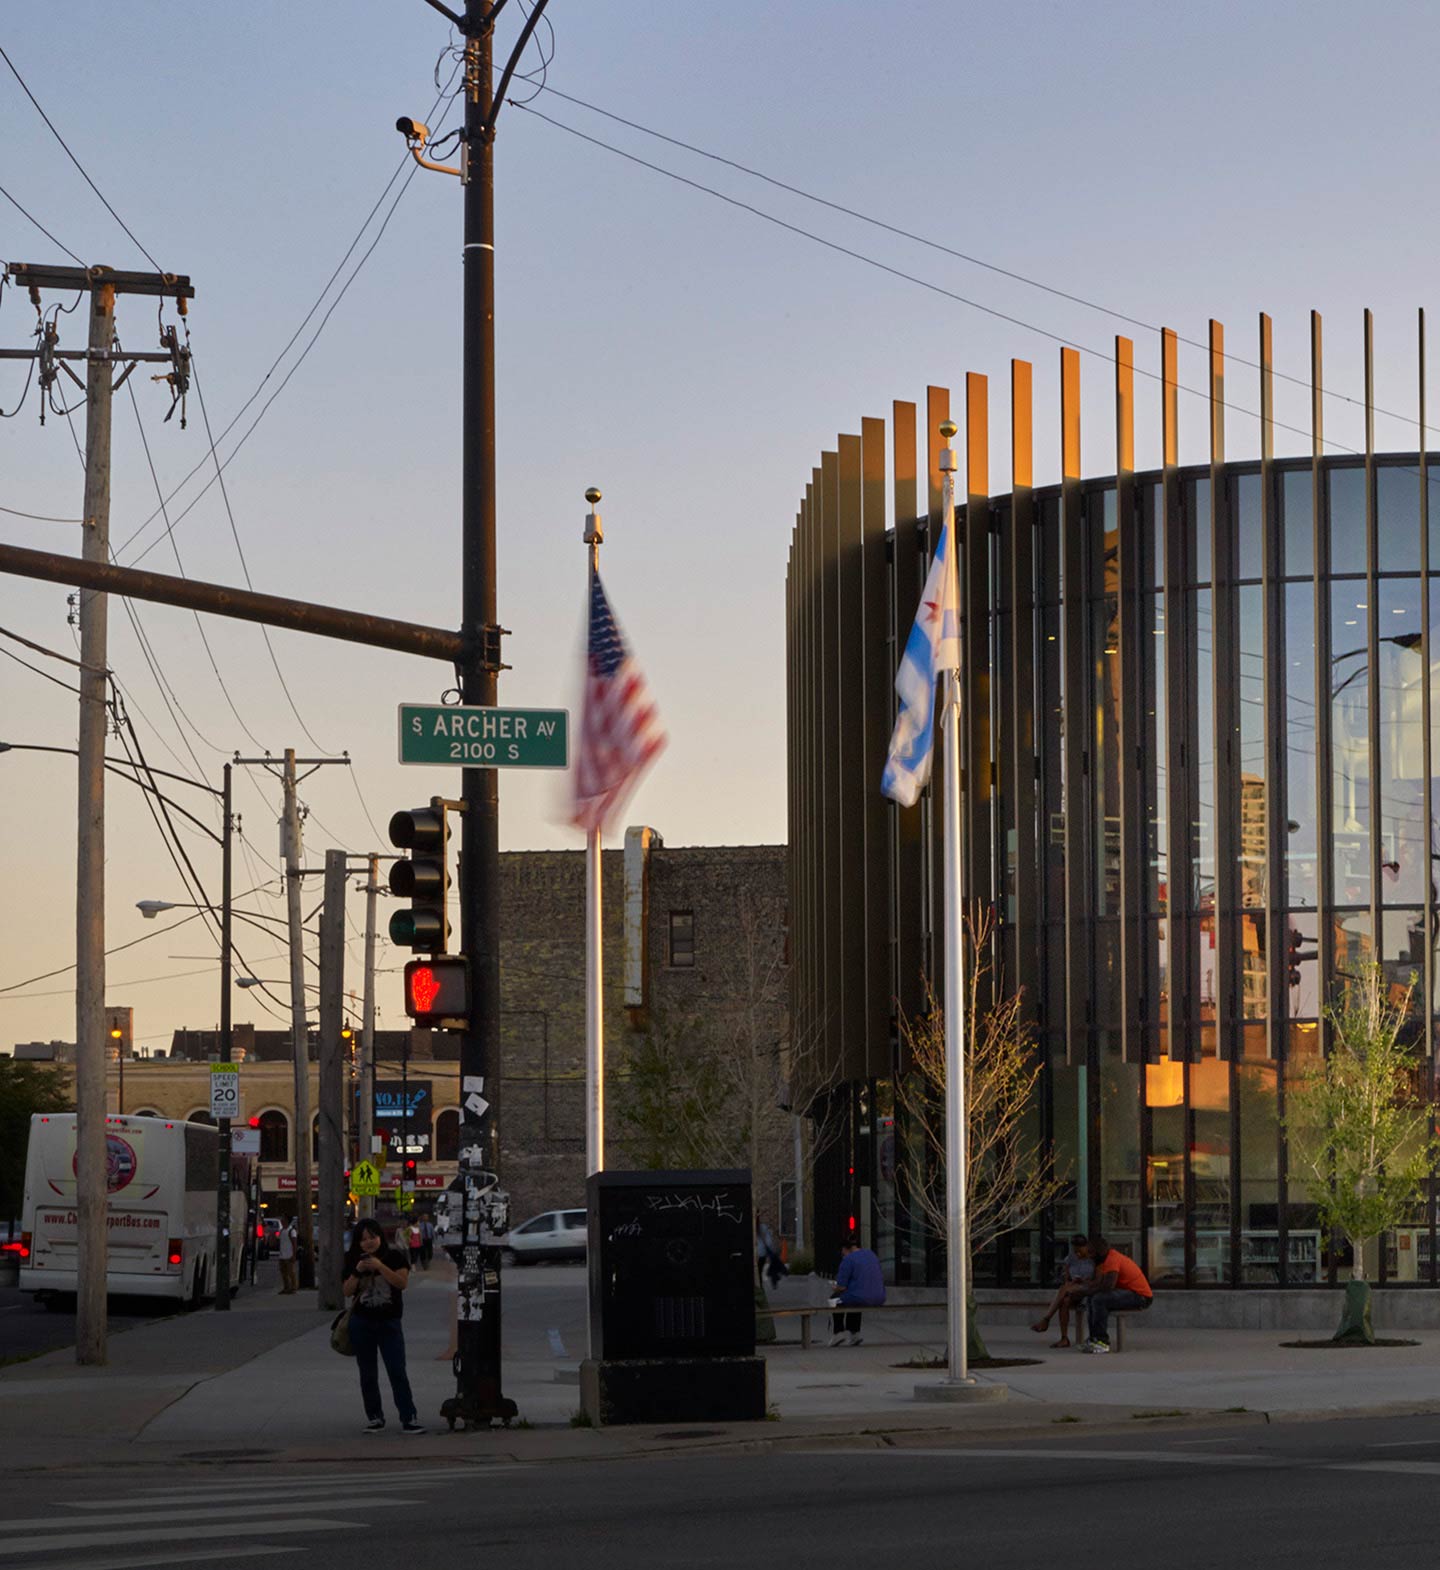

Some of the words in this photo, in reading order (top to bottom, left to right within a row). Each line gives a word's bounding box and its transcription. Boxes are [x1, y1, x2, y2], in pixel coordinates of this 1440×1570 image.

[412, 716, 422, 733] S
[433, 714, 528, 739] ARCHER
[536, 720, 556, 737] AV
[450, 742, 496, 759] 2100
[508, 743, 520, 760] S
[214, 1088, 236, 1102] 20
